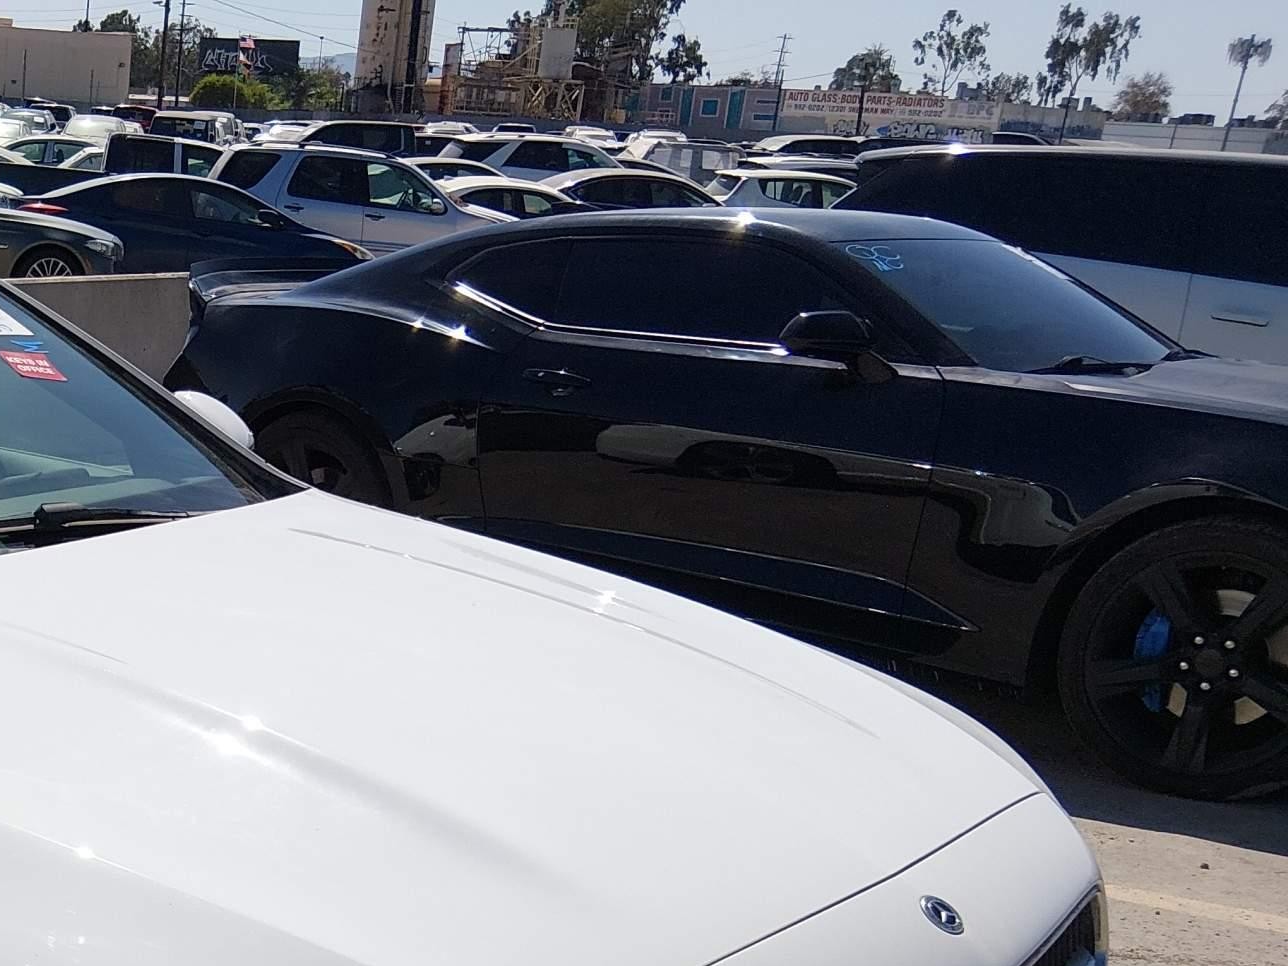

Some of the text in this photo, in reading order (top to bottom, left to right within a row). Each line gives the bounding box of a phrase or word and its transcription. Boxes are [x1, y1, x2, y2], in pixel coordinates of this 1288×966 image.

[788, 91, 809, 102] AUTO
[5, 356, 51, 368] KEYS IN
[16, 364, 57, 375] OFFICE
